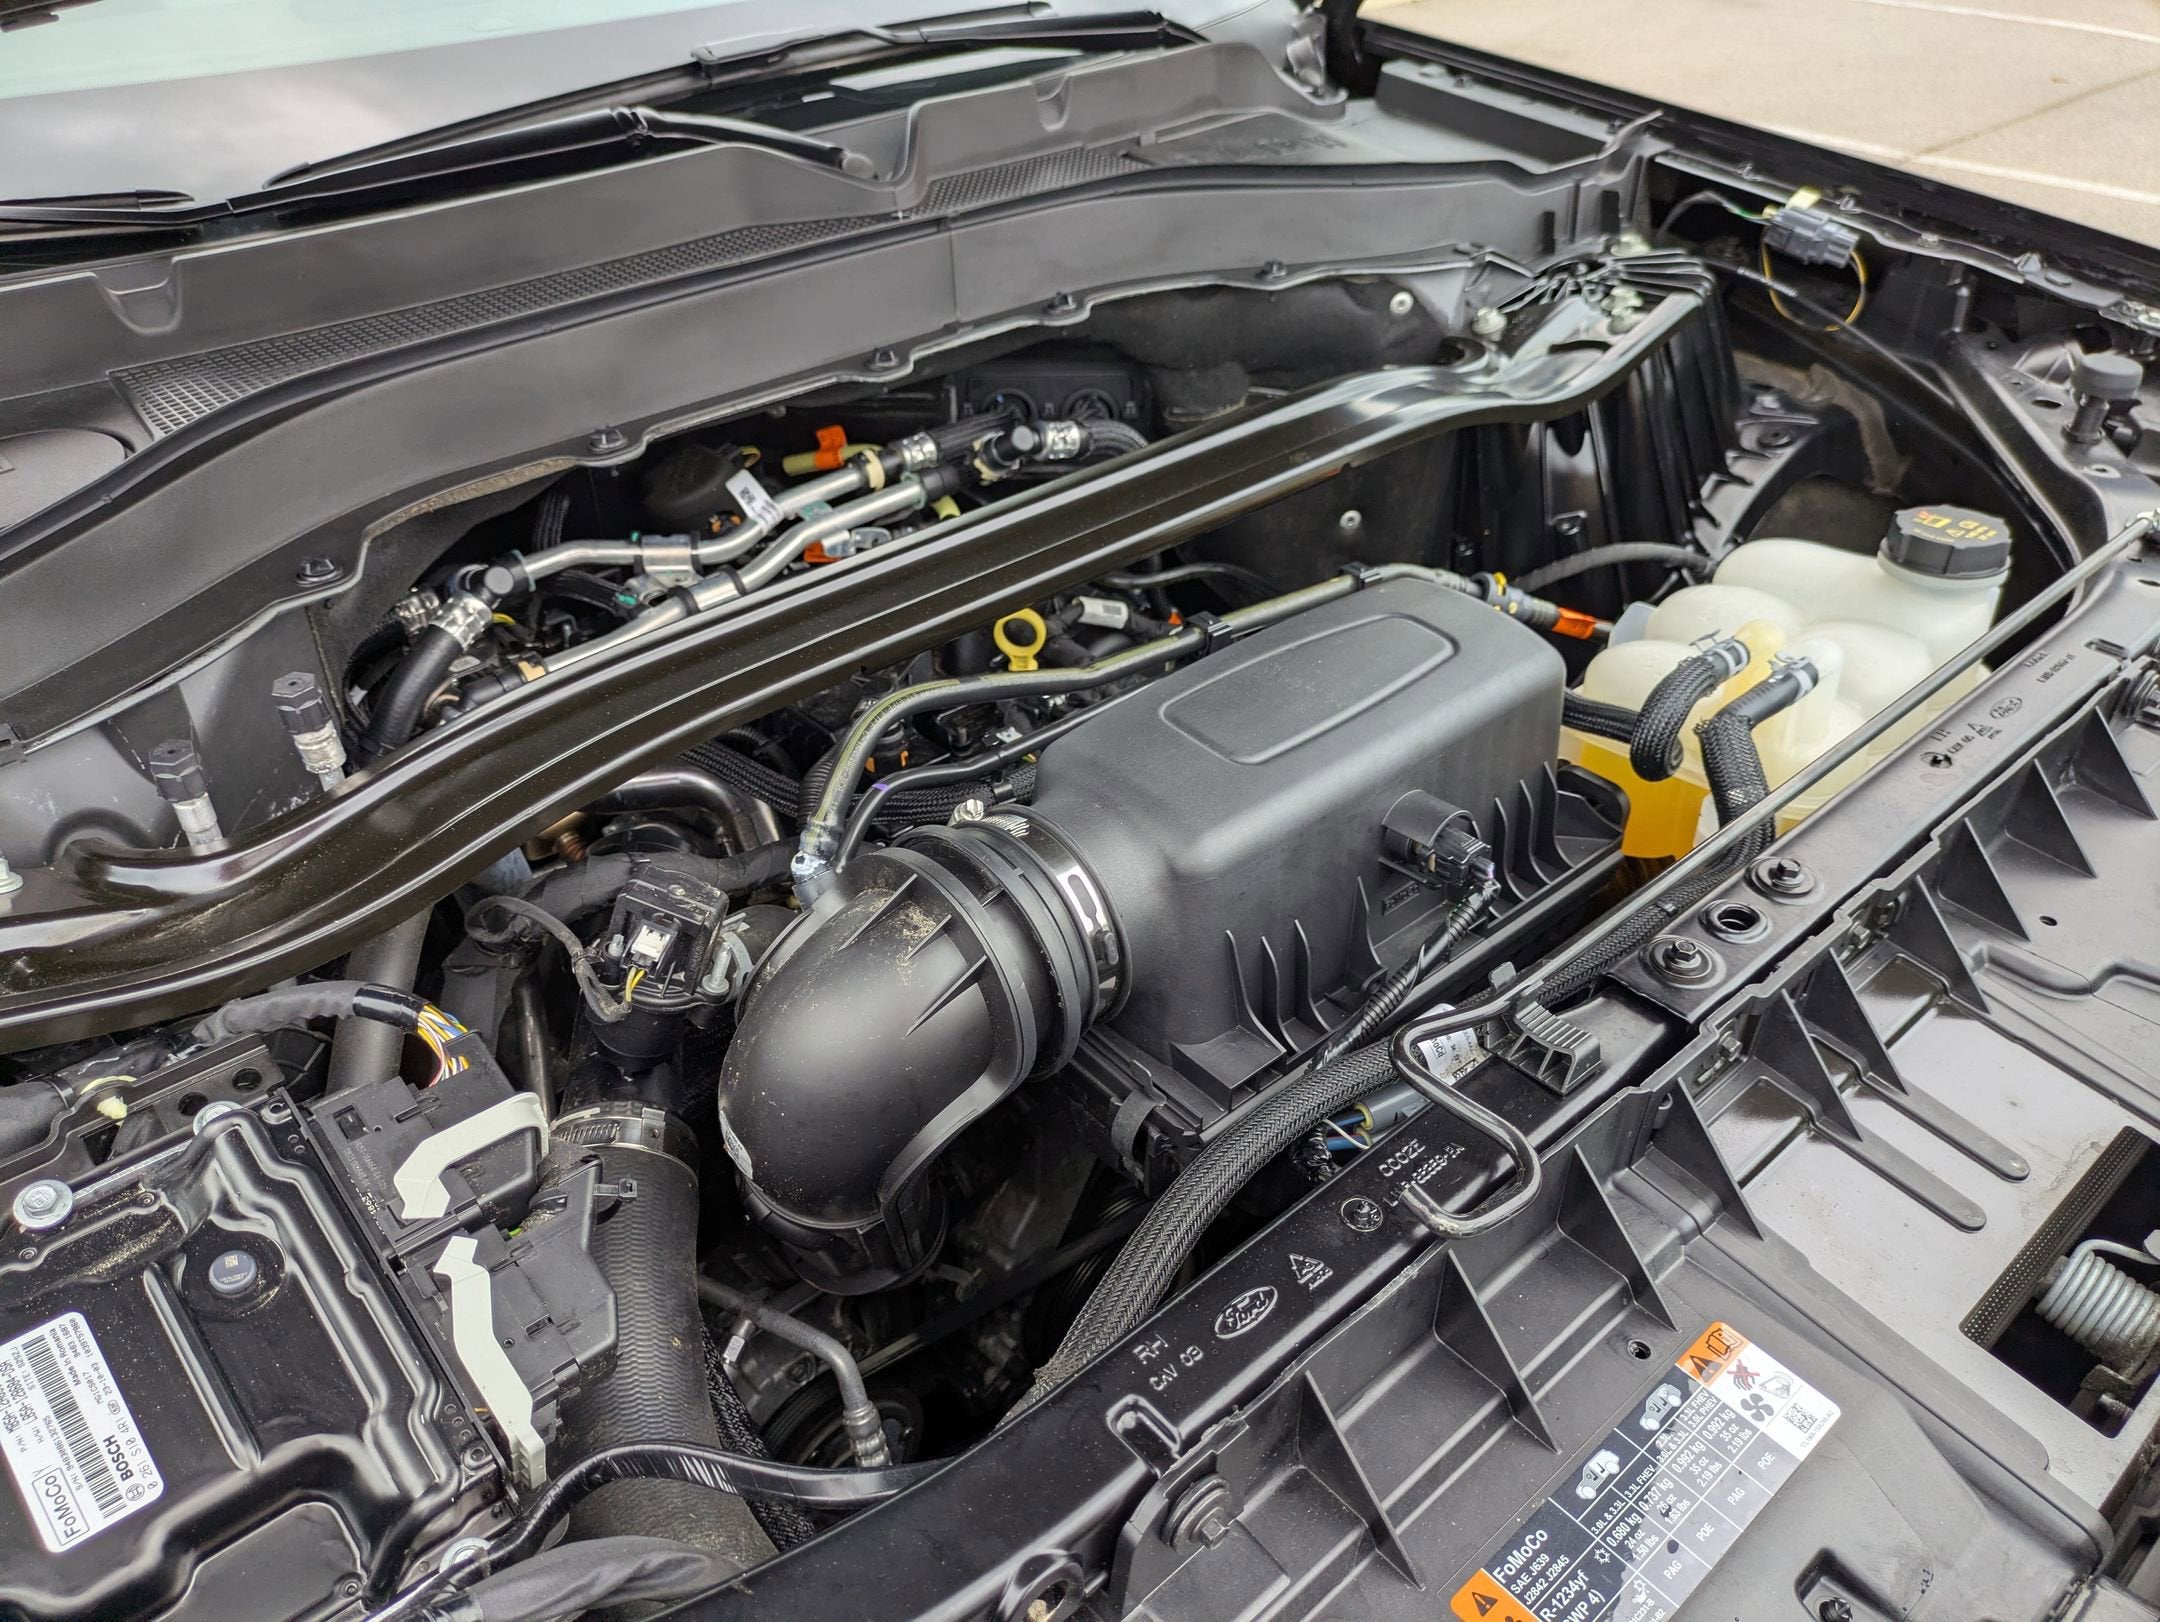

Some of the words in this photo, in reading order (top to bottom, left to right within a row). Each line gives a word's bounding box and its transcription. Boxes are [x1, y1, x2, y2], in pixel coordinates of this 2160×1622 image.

[47, 1327, 68, 1357] Romania
[1132, 1332, 1168, 1365] RH
[66, 1365, 82, 1386] Made
[1679, 1405, 1695, 1421] 3.3L
[1690, 1389, 1710, 1409] FHEV
[1687, 1412, 1704, 1428] 3.0L
[1698, 1395, 1718, 1416] PHEV
[1702, 1416, 1726, 1441] 0.992
[1718, 1405, 1737, 1424] kg
[1719, 1429, 1732, 1442] 35
[1728, 1423, 1739, 1434] oz
[1726, 1436, 1744, 1454] 2.19
[1737, 1425, 1753, 1441] lbs
[103, 1434, 133, 1480] BOSCH
[137, 1458, 153, 1478] 261
[1672, 1449, 1695, 1473] 0.992
[1688, 1438, 1707, 1457] kg
[1689, 1463, 1702, 1476] 35
[1698, 1456, 1710, 1468] oz
[1756, 1451, 1776, 1470] POE
[1623, 1480, 1641, 1499] 3.3L
[1635, 1464, 1656, 1484] FHEV
[1696, 1470, 1713, 1488] 2.19
[1707, 1459, 1723, 1475] lbs
[40, 1474, 81, 1537] FoMoCo
[1607, 1496, 1626, 1515] 3.3L
[1638, 1487, 1662, 1511] 0.737
[1655, 1475, 1675, 1494] kg
[1656, 1500, 1670, 1514] 26
[1665, 1493, 1677, 1505] oz
[1726, 1486, 1747, 1506] PAG
[1603, 1510, 1613, 1520] &
[1663, 1507, 1682, 1525] 1.63
[1675, 1496, 1691, 1513] lbs
[1590, 1517, 1607, 1535] 3.0L
[1605, 1521, 1630, 1546] 0.680
[1623, 1509, 1643, 1528] kg
[1623, 1536, 1637, 1549] 24
[1633, 1528, 1645, 1540] oz
[1695, 1521, 1715, 1541] POE
[1492, 1525, 1549, 1584] FoMoCo
[1631, 1544, 1649, 1562] 1.50
[1642, 1532, 1659, 1549] lbs
[1509, 1571, 1533, 1595] SAE
[1527, 1552, 1550, 1576] J639
[1522, 1577, 1548, 1604] J2842
[1543, 1554, 1569, 1580] J2845
[1662, 1558, 1683, 1580] PAG
[1540, 1570, 1592, 1622] R-1234yf
[1580, 1588, 1606, 1614] 4)
